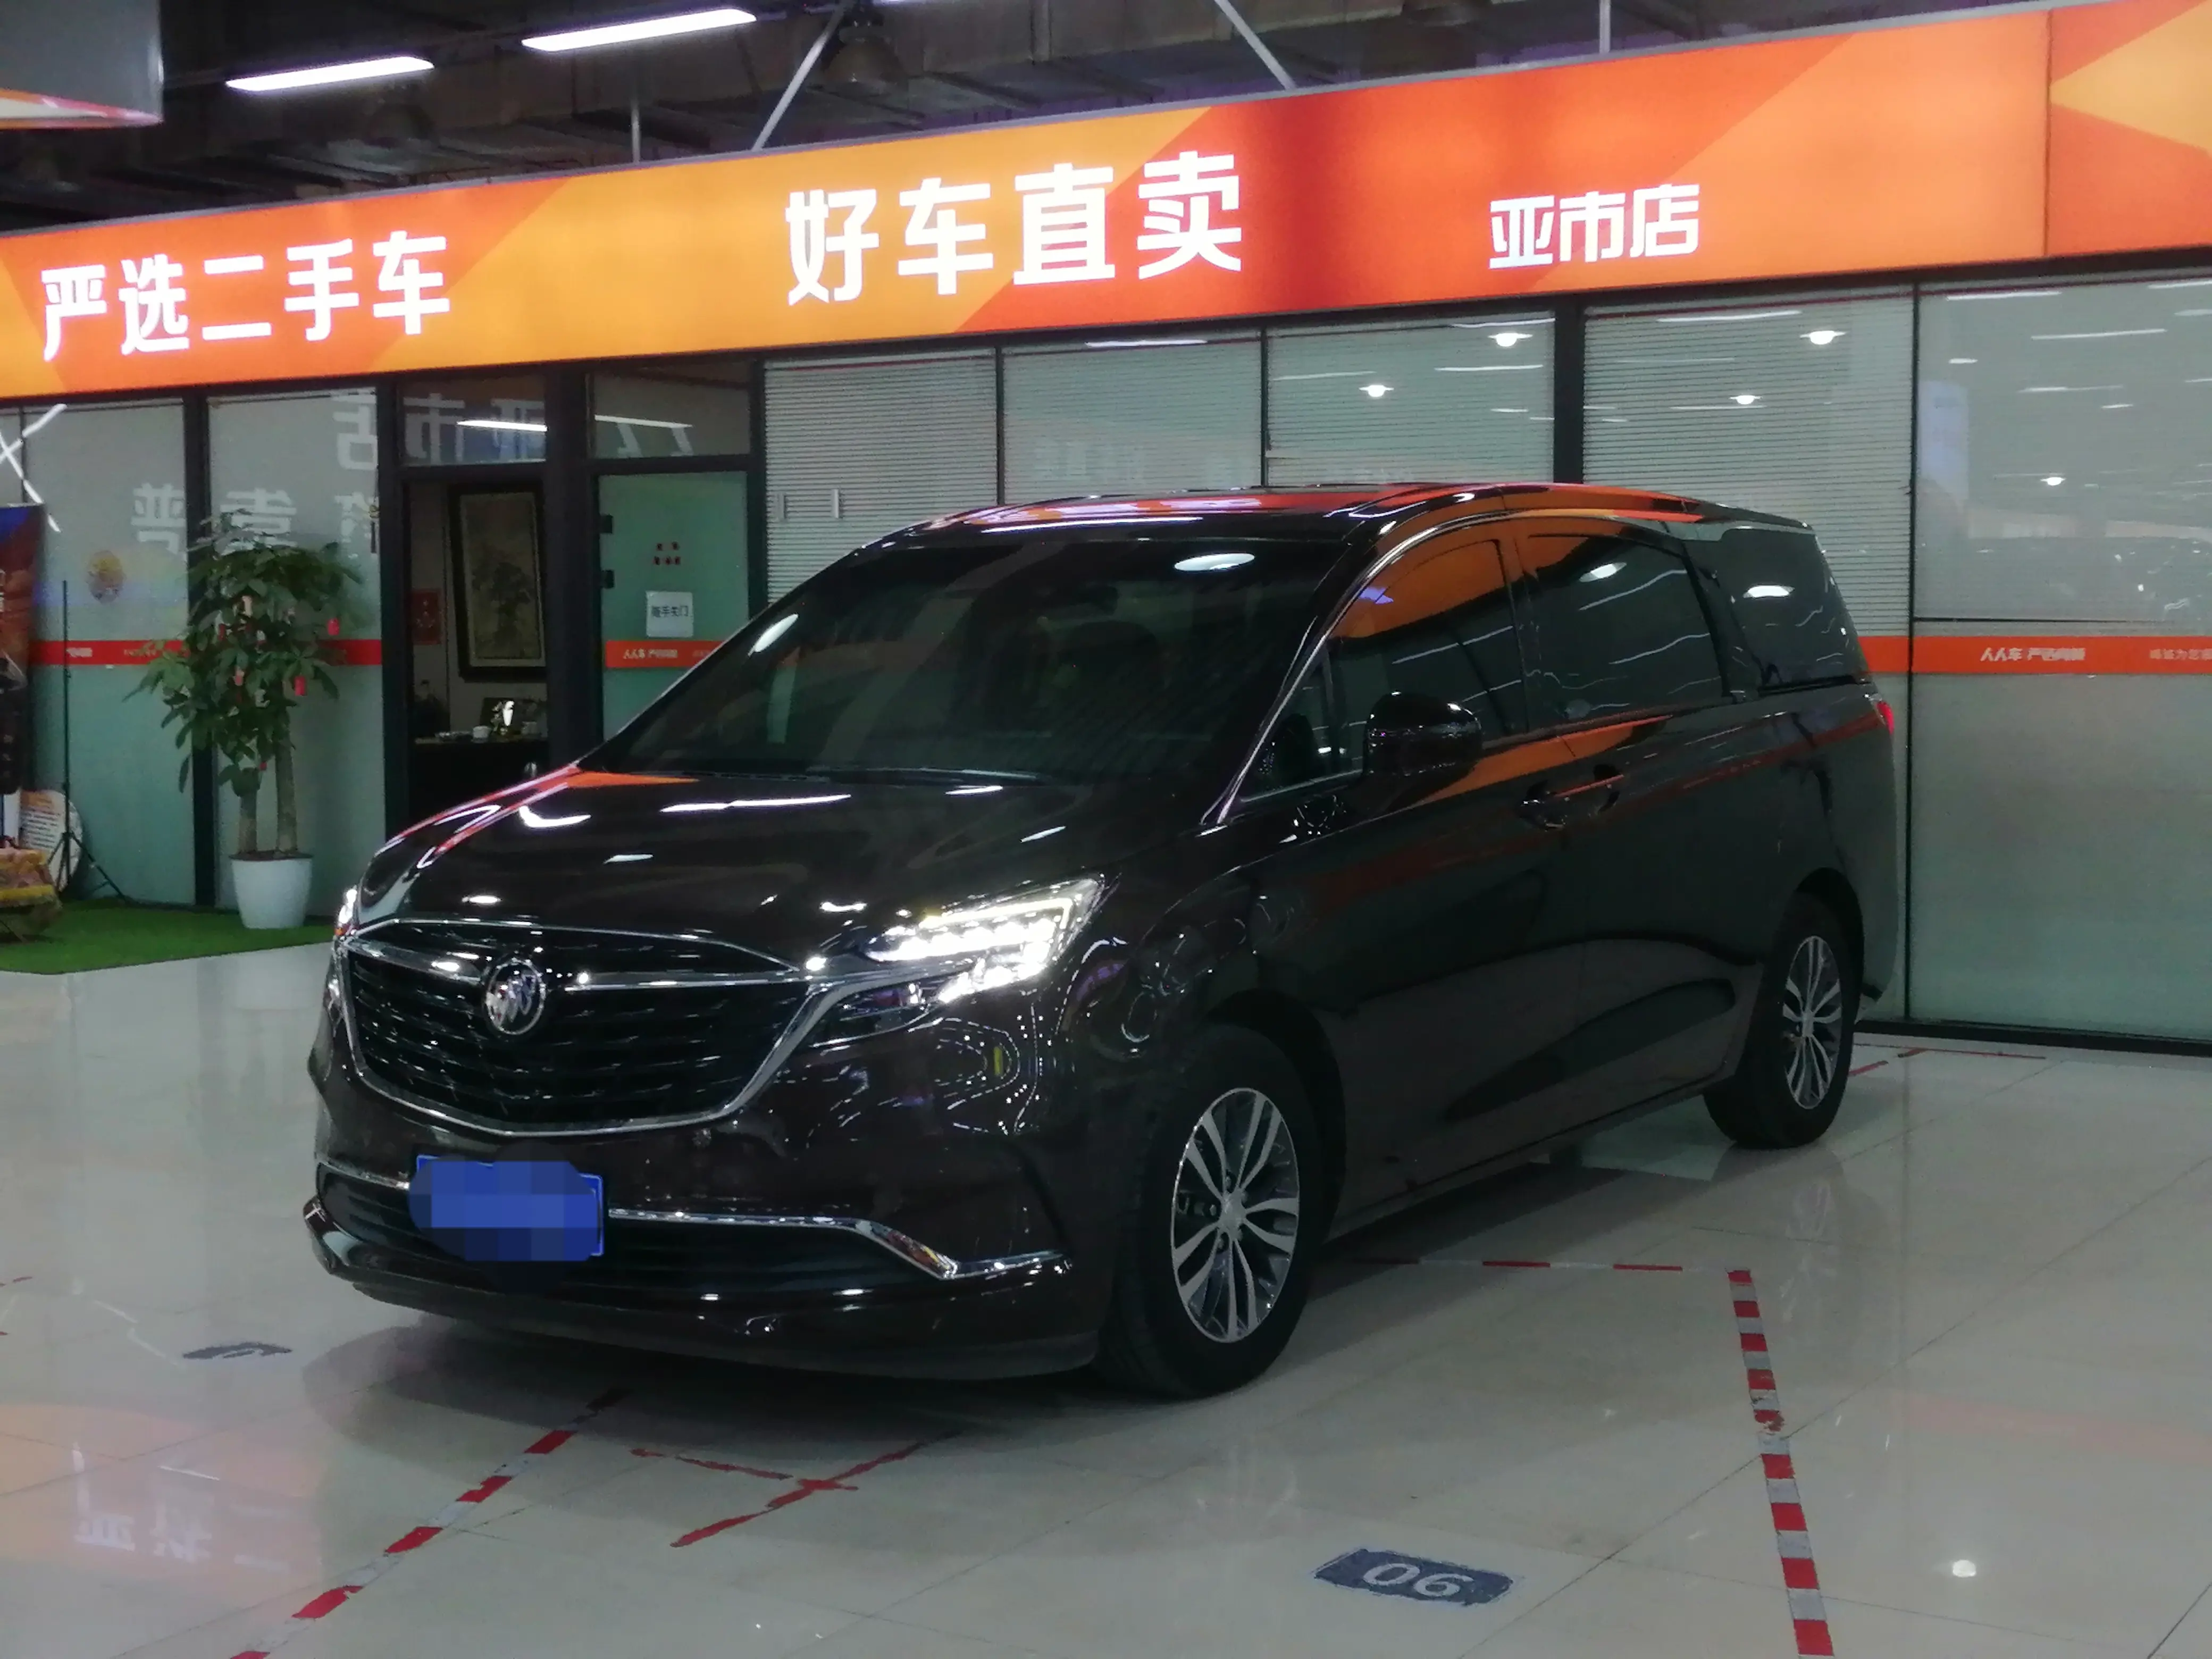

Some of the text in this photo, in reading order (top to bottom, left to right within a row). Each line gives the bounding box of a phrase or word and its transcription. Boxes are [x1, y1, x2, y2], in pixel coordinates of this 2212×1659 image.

[785, 150, 1242, 306] 好车直卖
[1489, 184, 1700, 269] 亚市店
[40, 231, 450, 362] 严选二手车
[1980, 647, 2023, 661] 人人车
[1362, 1562, 1474, 1597] 06
